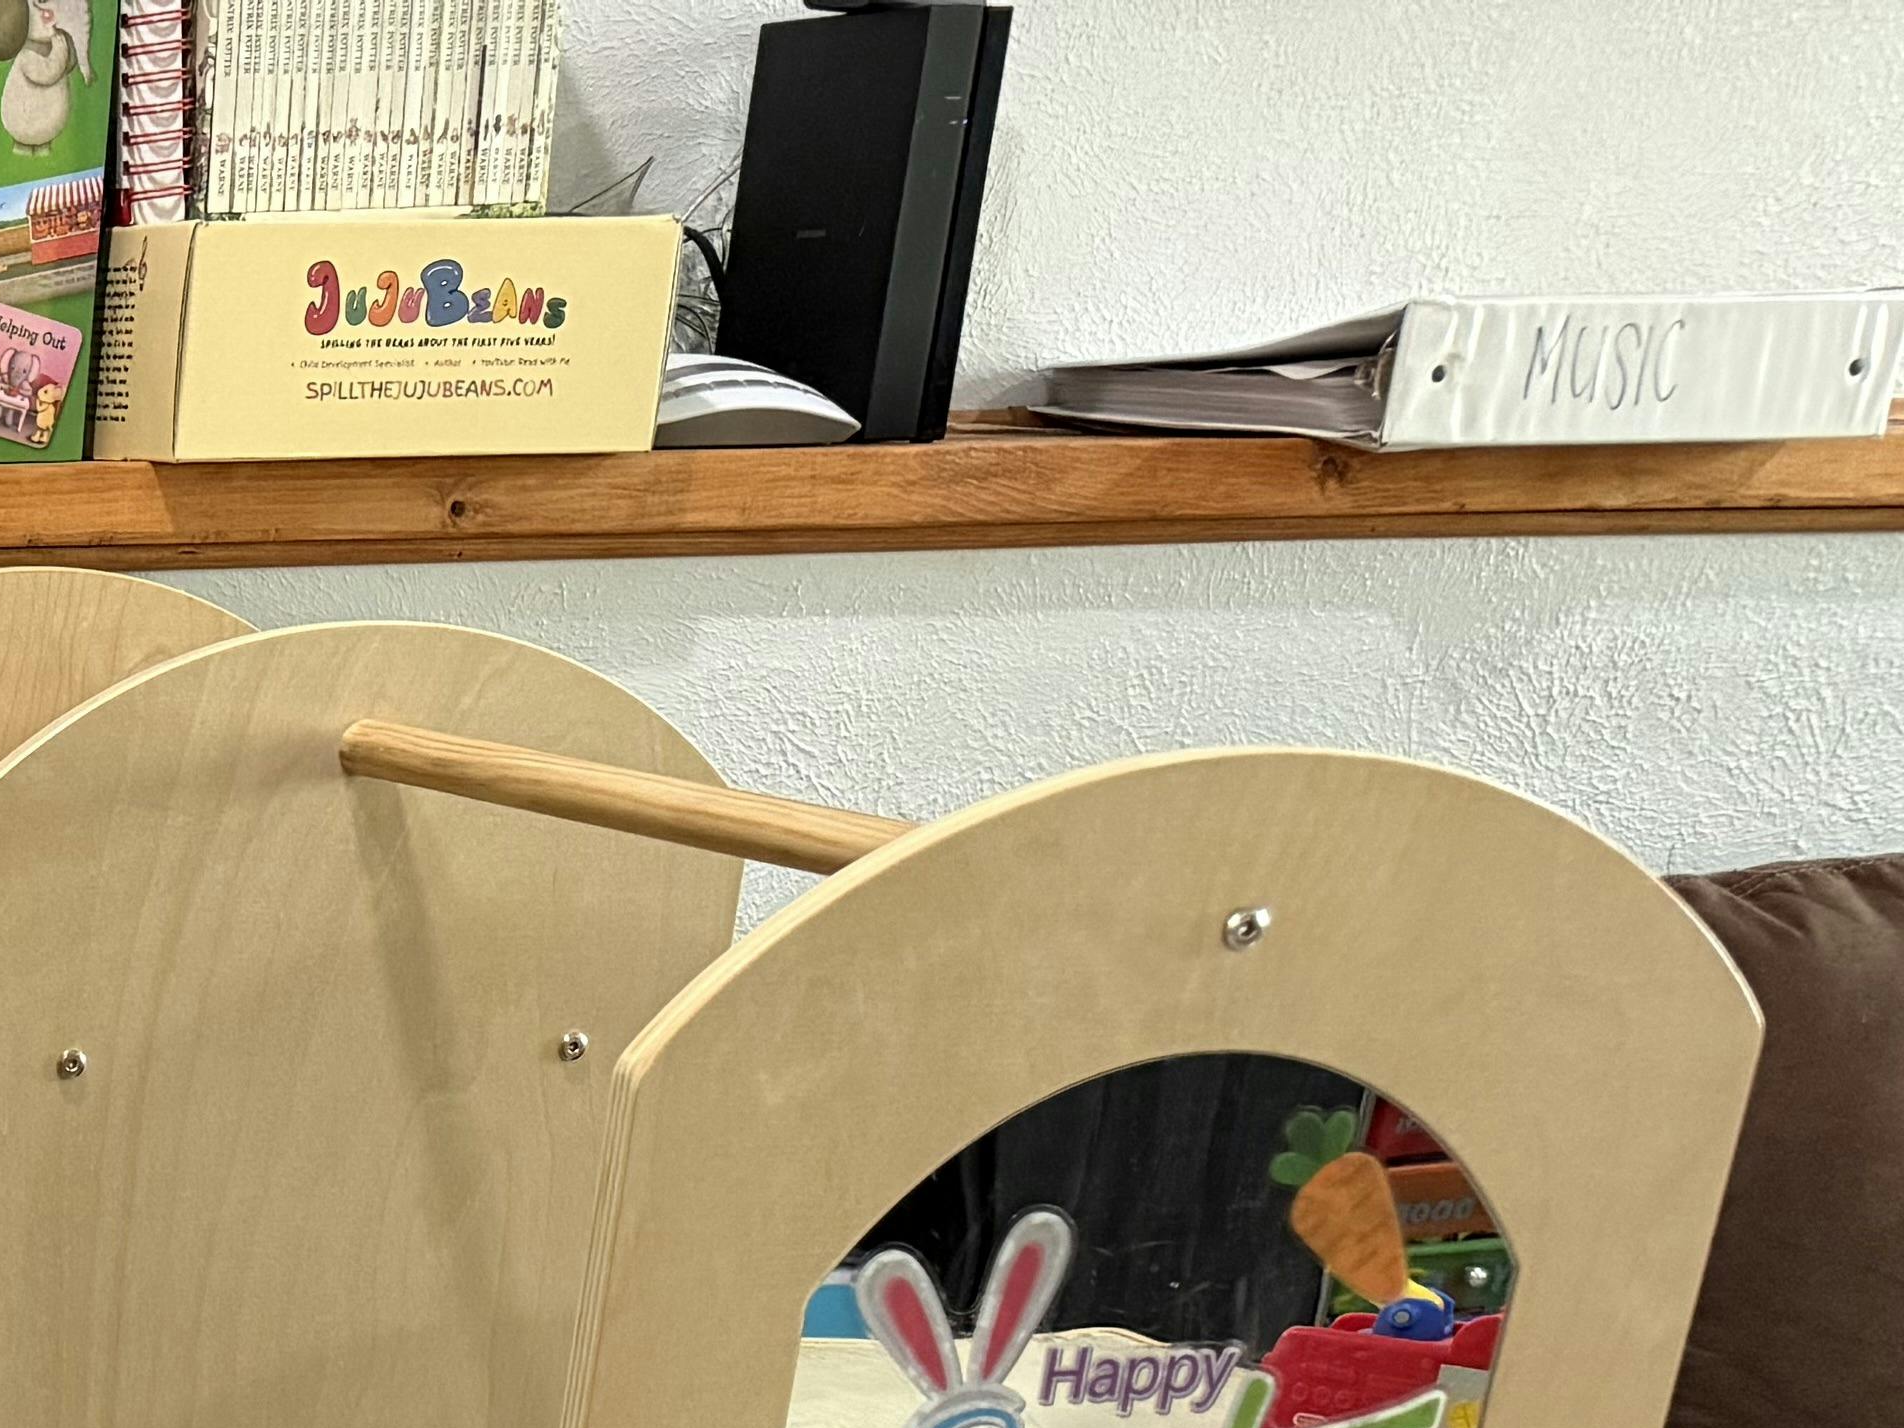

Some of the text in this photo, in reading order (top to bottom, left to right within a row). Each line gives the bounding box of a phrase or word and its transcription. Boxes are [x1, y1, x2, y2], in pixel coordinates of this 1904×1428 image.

[43, 332, 68, 351] Out
[320, 338, 362, 348] SPILLING
[365, 338, 382, 348] THE
[385, 337, 415, 348] BEANS
[417, 337, 448, 347] ABOUT
[452, 336, 469, 347] THE
[471, 336, 497, 347] FIRST
[500, 336, 521, 346] FIVE
[1524, 315, 1685, 411] MUSIC
[304, 377, 554, 401] SPILLTHEJUJUBEANS.COM
[1039, 1346, 1238, 1415] Happy
